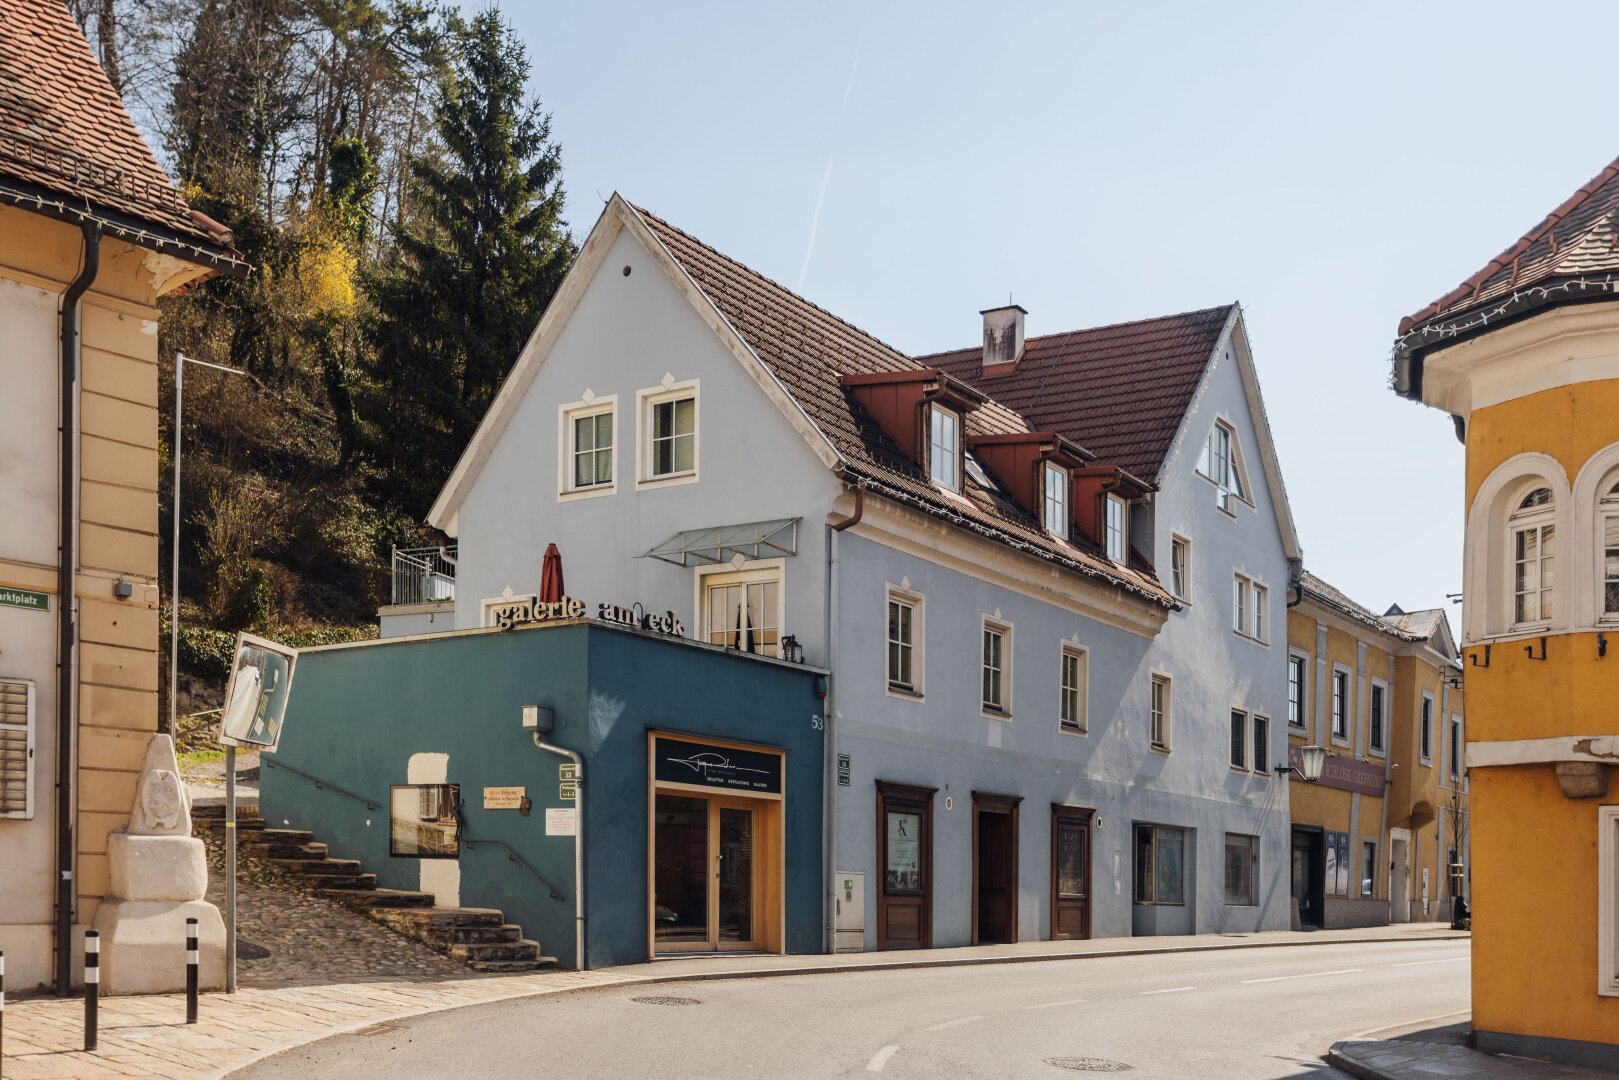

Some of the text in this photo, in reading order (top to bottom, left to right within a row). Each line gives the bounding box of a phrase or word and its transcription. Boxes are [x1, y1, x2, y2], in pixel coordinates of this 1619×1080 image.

[499, 596, 687, 636] galerie am eck
[812, 714, 823, 730] 53
